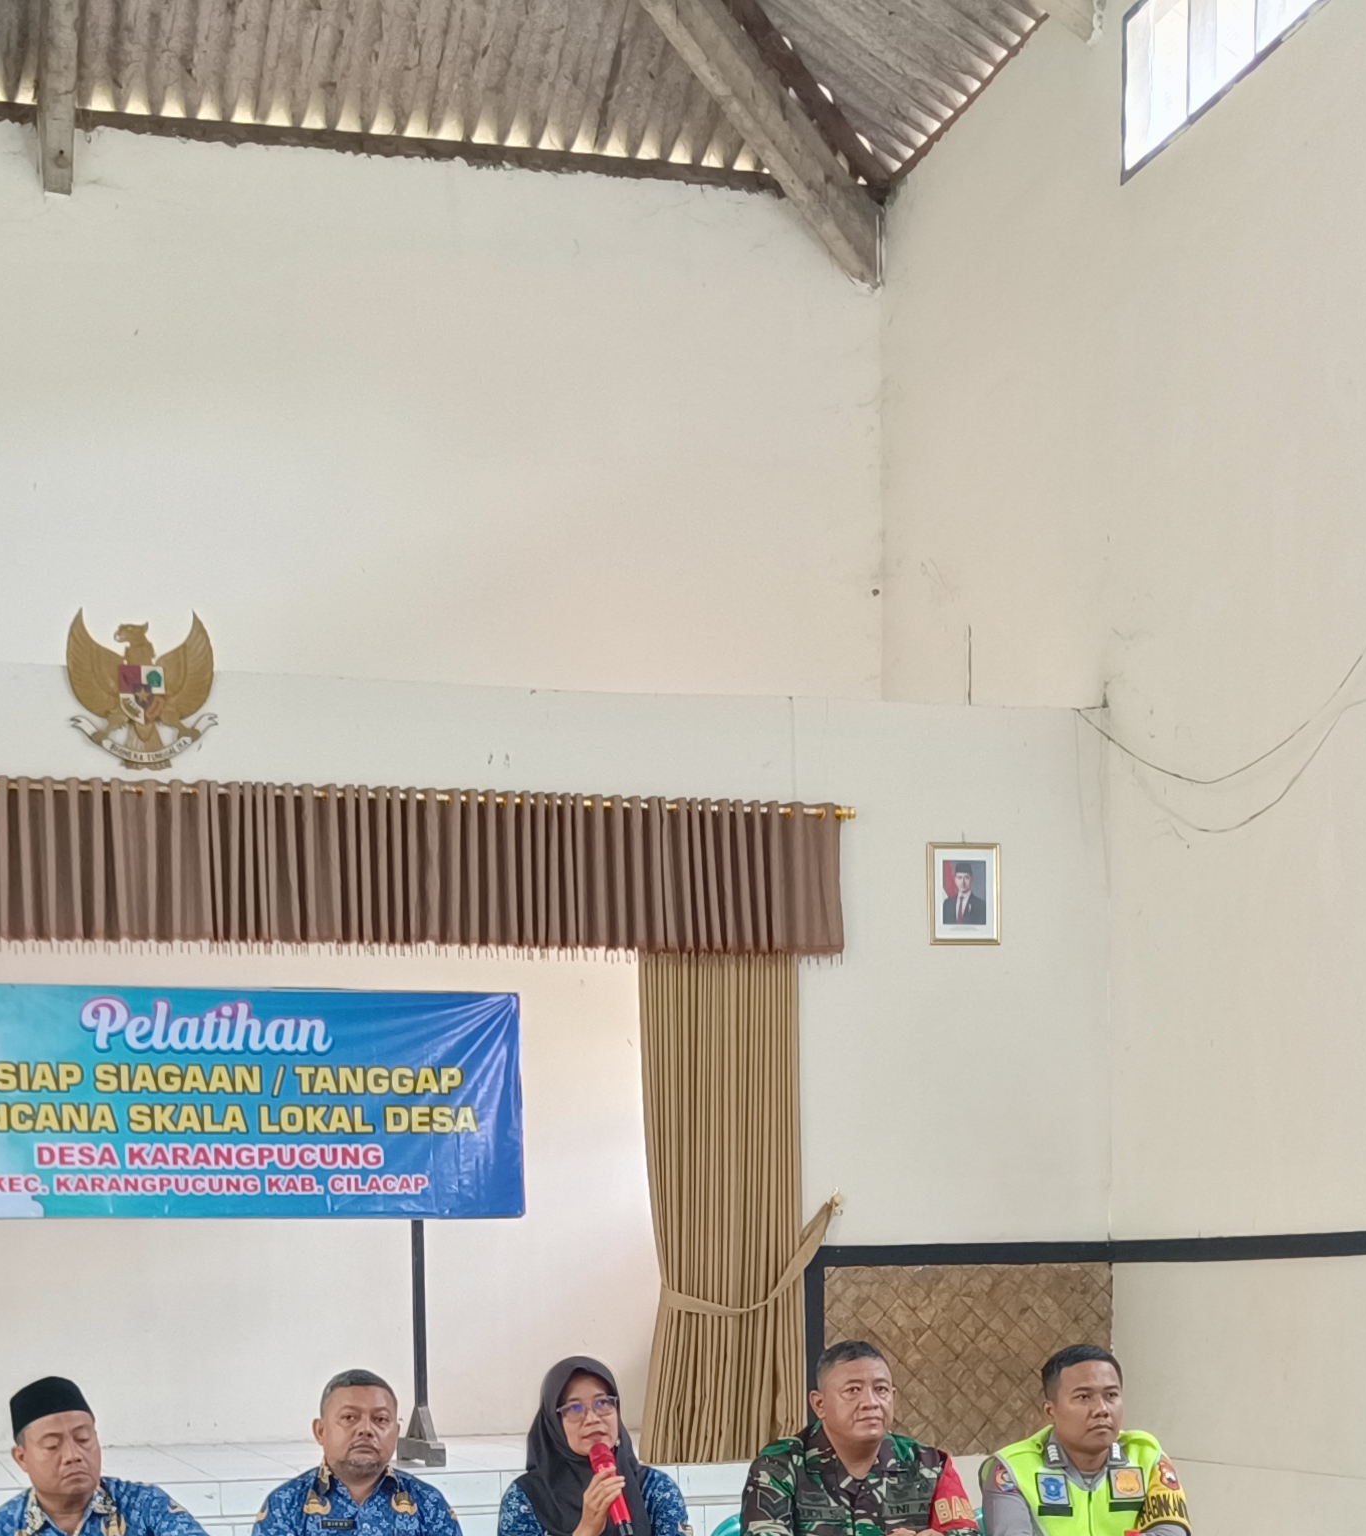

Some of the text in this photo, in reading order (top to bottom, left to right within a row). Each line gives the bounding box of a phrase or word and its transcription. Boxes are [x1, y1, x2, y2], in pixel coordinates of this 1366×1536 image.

[81, 996, 332, 1053] Pelatihan
[93, 1062, 262, 1095] SIAGAAN
[270, 1064, 285, 1097] /
[293, 1065, 464, 1096] TANGGAP
[127, 1103, 248, 1134] SKALA
[258, 1104, 375, 1135] LOKAL
[383, 1104, 479, 1135] DESA
[35, 1144, 384, 1169] DESA KARANGPUCUNG
[55, 1175, 261, 1195] KARANGPUCUNG
[265, 1176, 323, 1194] KAB.
[329, 1175, 430, 1195] CILACAP
